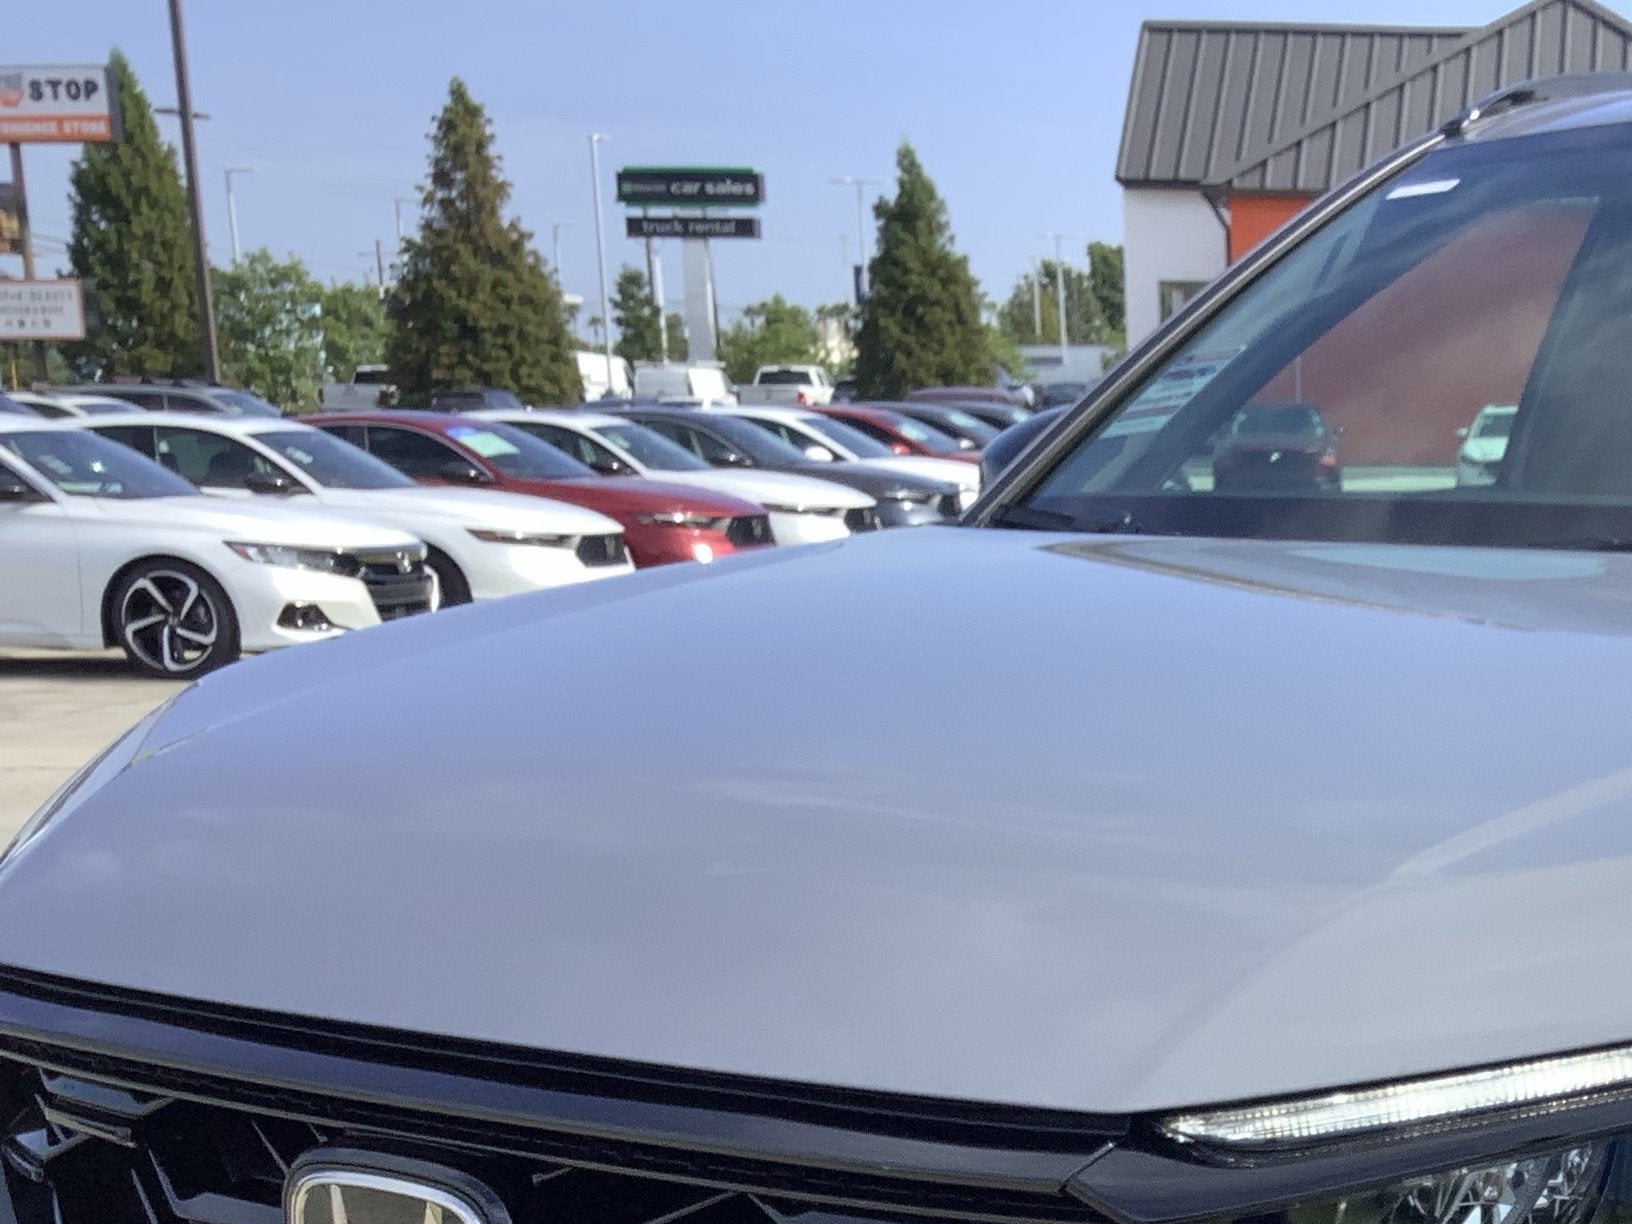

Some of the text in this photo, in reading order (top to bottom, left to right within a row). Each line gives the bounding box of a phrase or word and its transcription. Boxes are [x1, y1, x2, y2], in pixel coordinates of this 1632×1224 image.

[29, 78, 99, 101] STOP
[669, 181, 700, 196] car
[704, 177, 755, 196] sales
